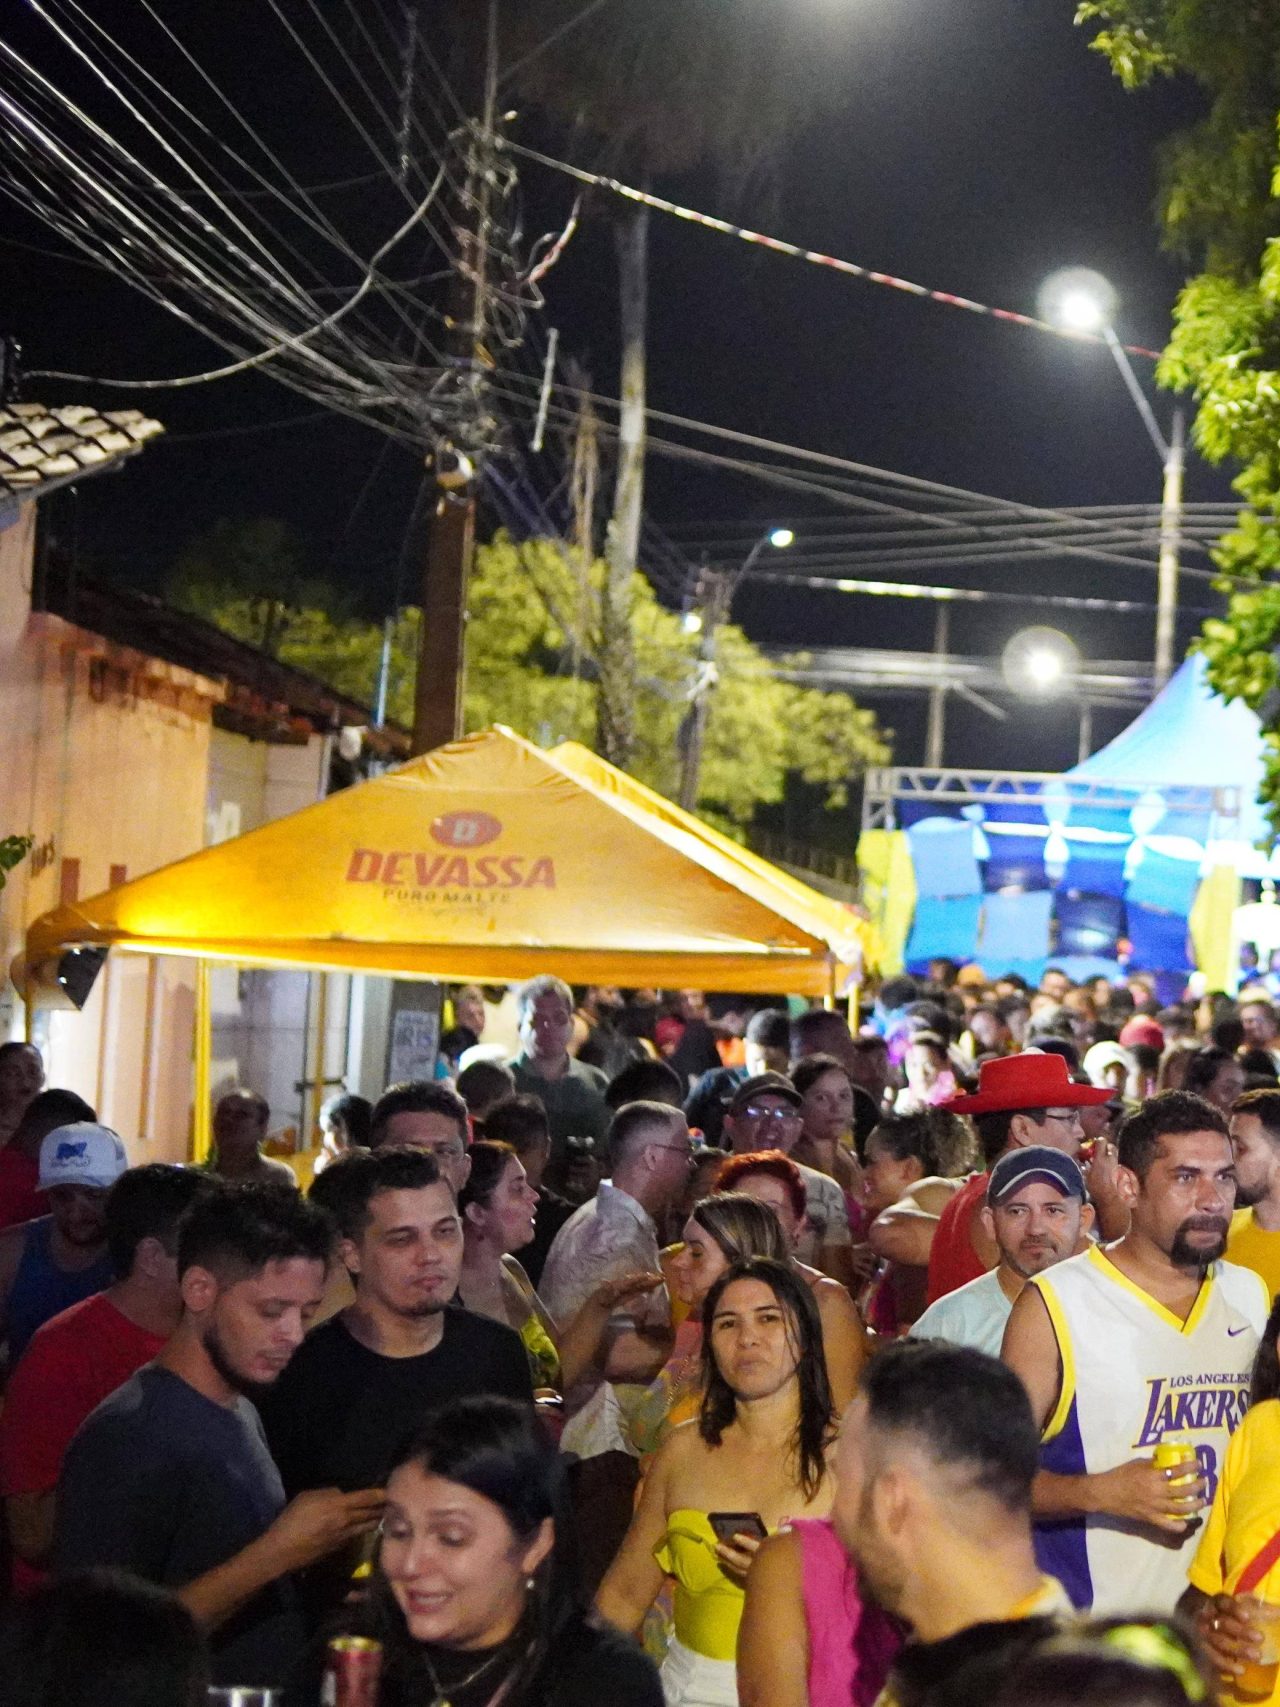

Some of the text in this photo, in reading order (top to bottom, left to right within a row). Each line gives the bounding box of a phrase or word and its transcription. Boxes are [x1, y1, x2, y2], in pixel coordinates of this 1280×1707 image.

[453, 820, 478, 840] D
[346, 849, 557, 889] DEVASSA
[383, 888, 511, 903] PURO MALTE
[1170, 1373, 1251, 1387] LOS ANGELES
[1132, 1378, 1251, 1448] LAKERS
